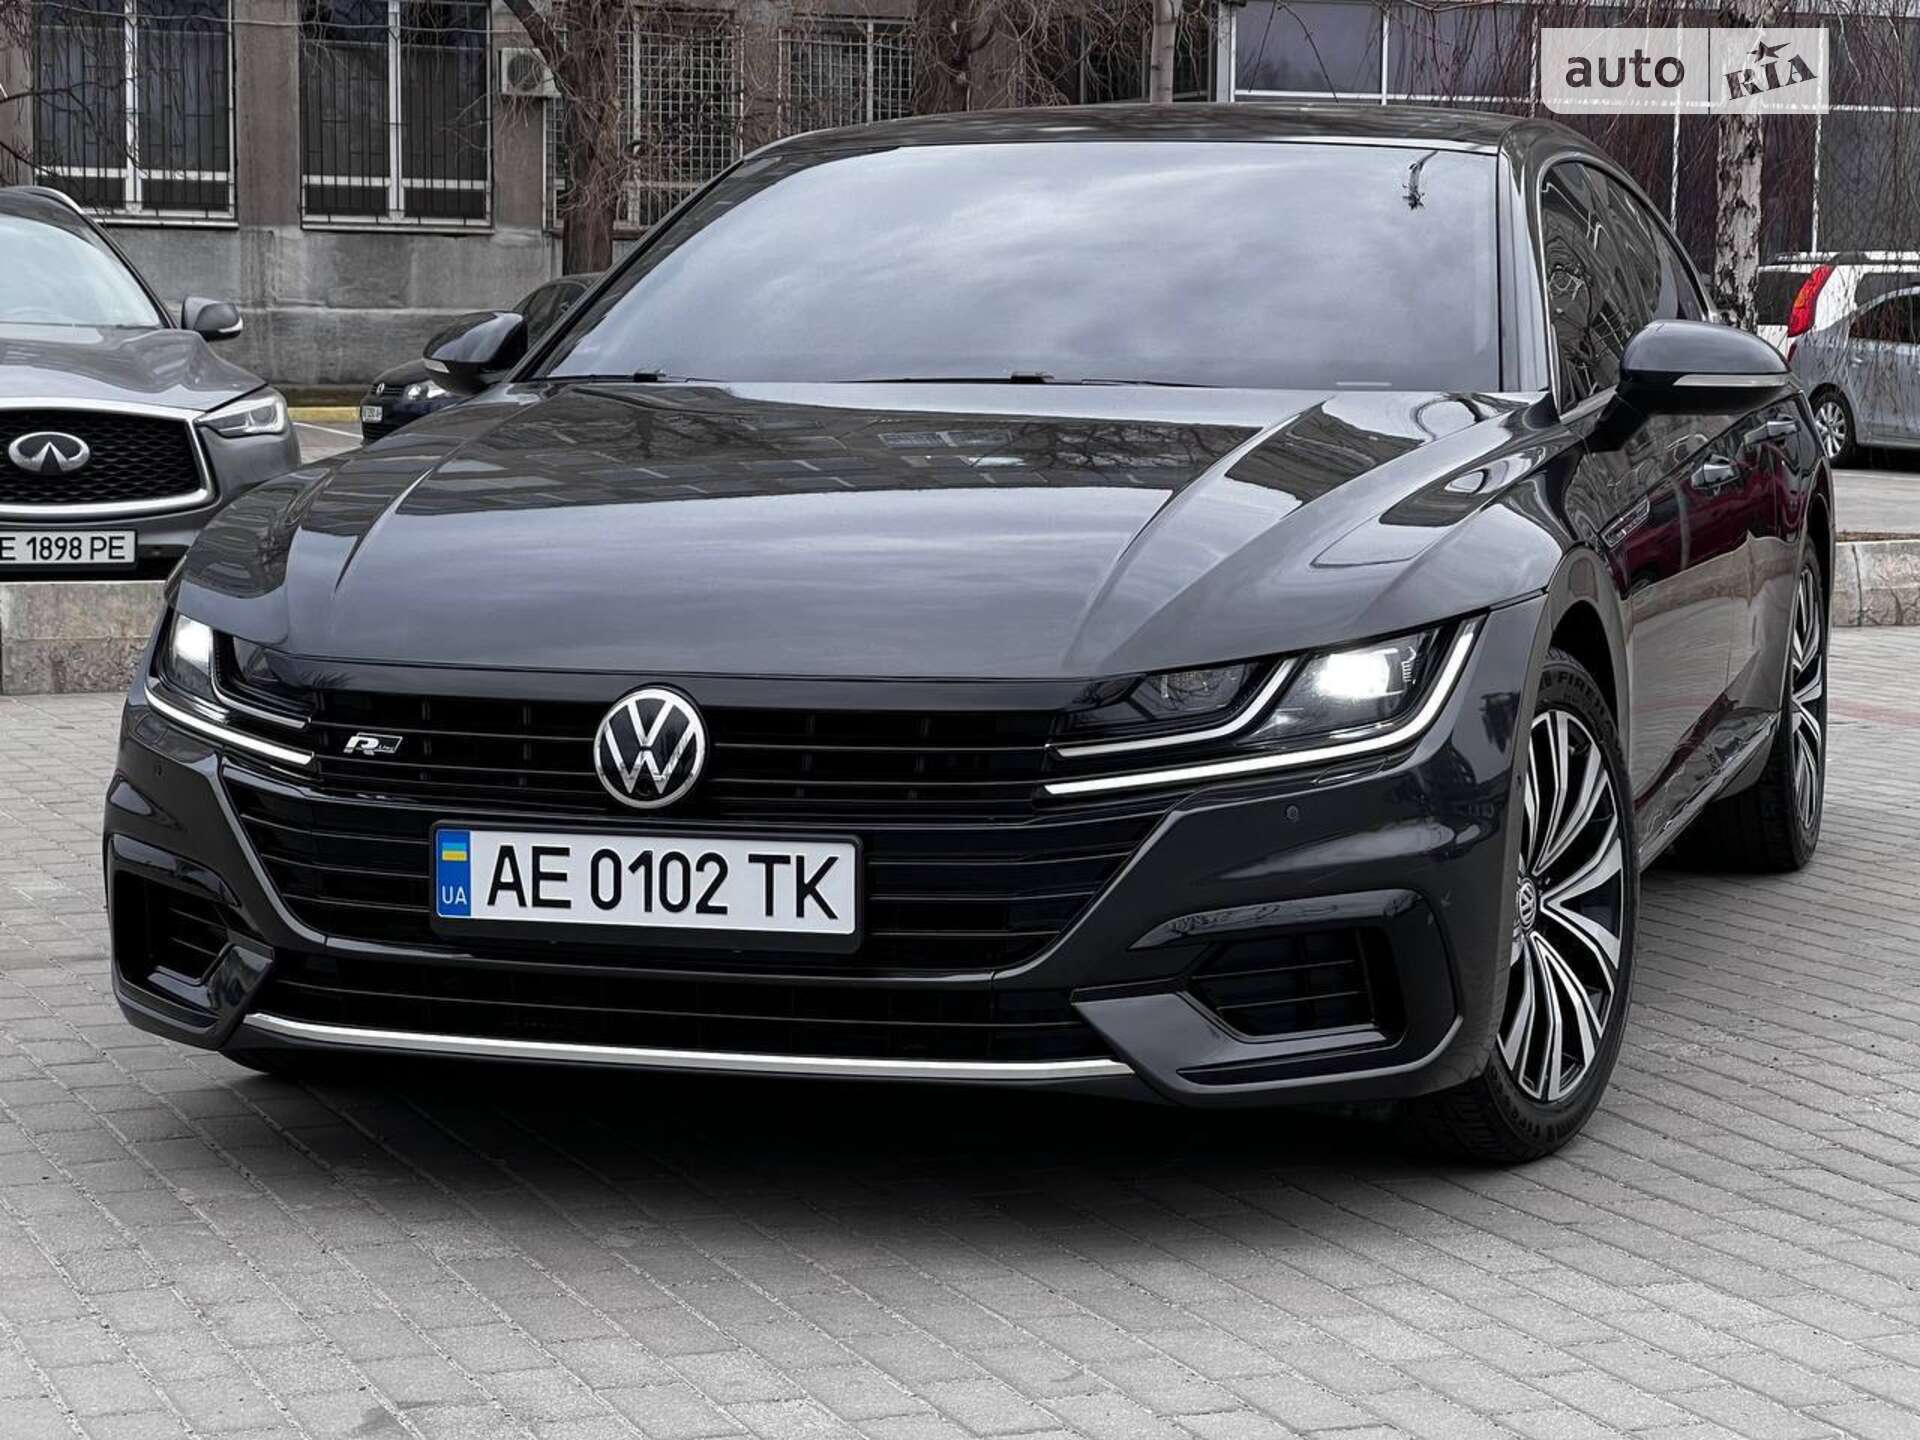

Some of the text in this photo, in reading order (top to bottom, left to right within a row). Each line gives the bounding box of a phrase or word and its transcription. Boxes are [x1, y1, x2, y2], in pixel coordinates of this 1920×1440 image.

[26, 536, 82, 560] 1898
[90, 536, 125, 560] PE
[486, 844, 839, 920] AE 0102 TK
[442, 885, 467, 904] UA
